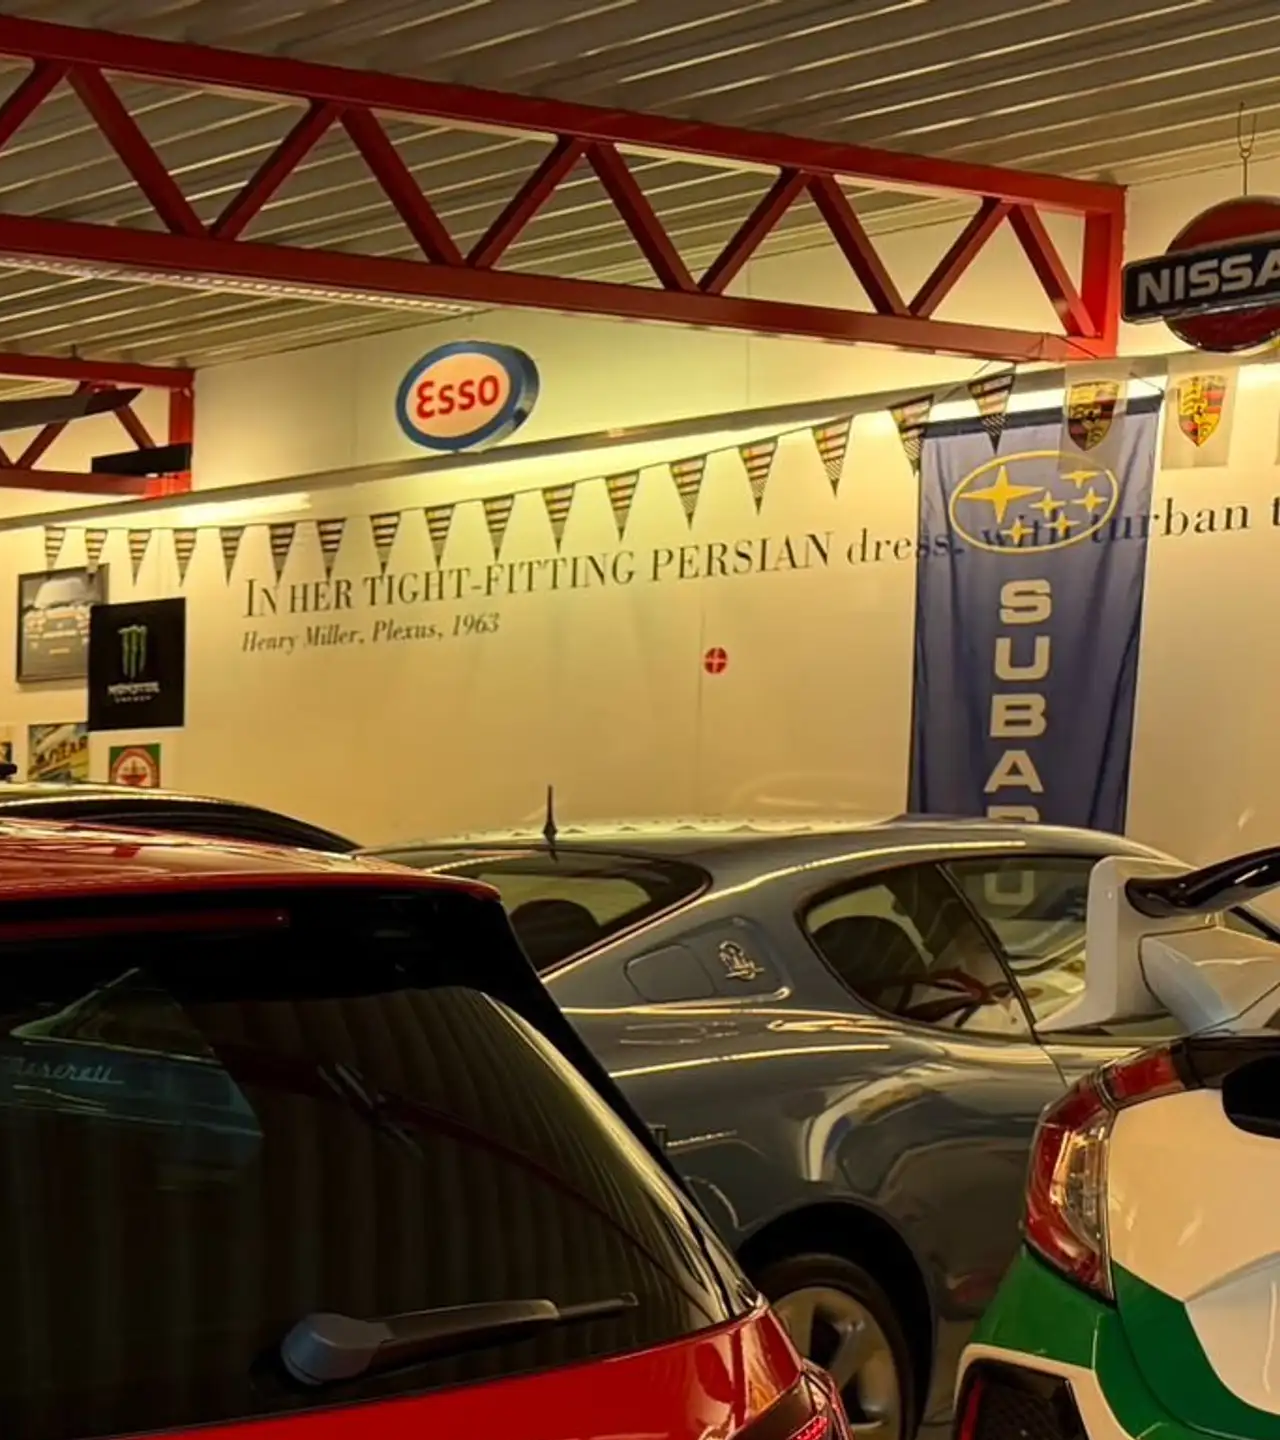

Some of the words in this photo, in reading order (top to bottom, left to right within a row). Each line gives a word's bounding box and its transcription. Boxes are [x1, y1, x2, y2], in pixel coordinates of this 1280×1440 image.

[289, 579, 353, 614] HER
[363, 550, 635, 607] TIGHT-FITTING
[647, 531, 835, 583] PERSIAN
[1091, 497, 1252, 543] turban
[242, 630, 299, 654] Henry
[452, 611, 500, 637] 1963
